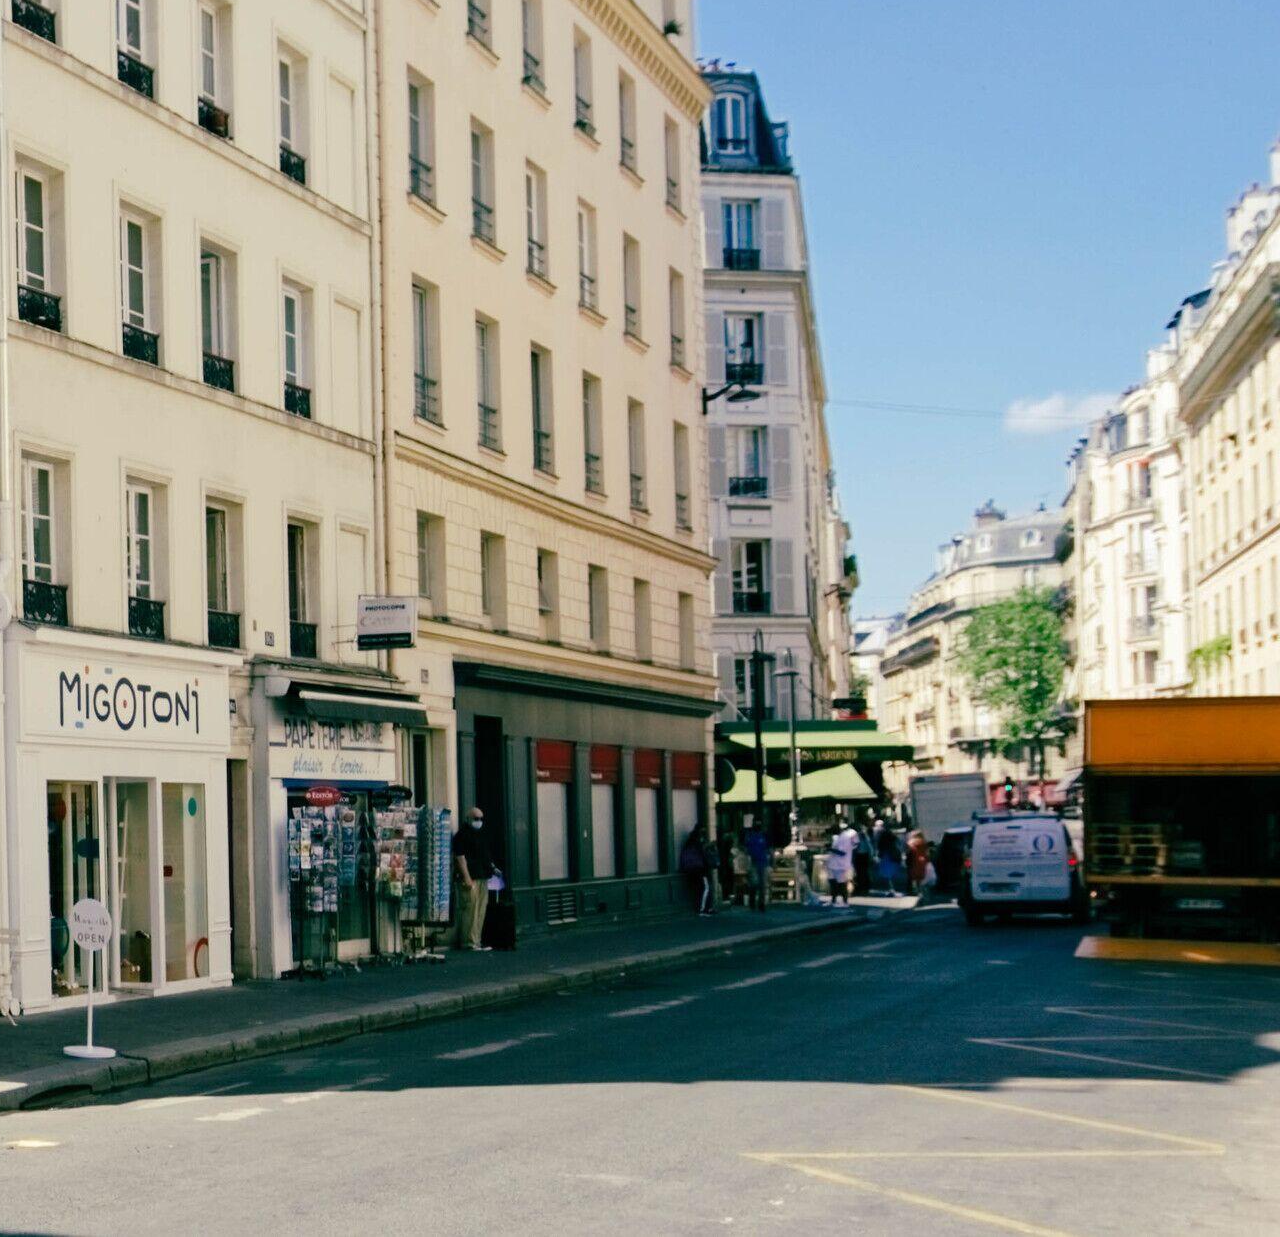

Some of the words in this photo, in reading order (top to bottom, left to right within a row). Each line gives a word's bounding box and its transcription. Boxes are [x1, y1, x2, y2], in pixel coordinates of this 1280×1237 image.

[365, 604, 406, 612] PHOTOCOPIE
[284, 717, 344, 751] PAPETERIE
[77, 932, 105, 943] OPEN
